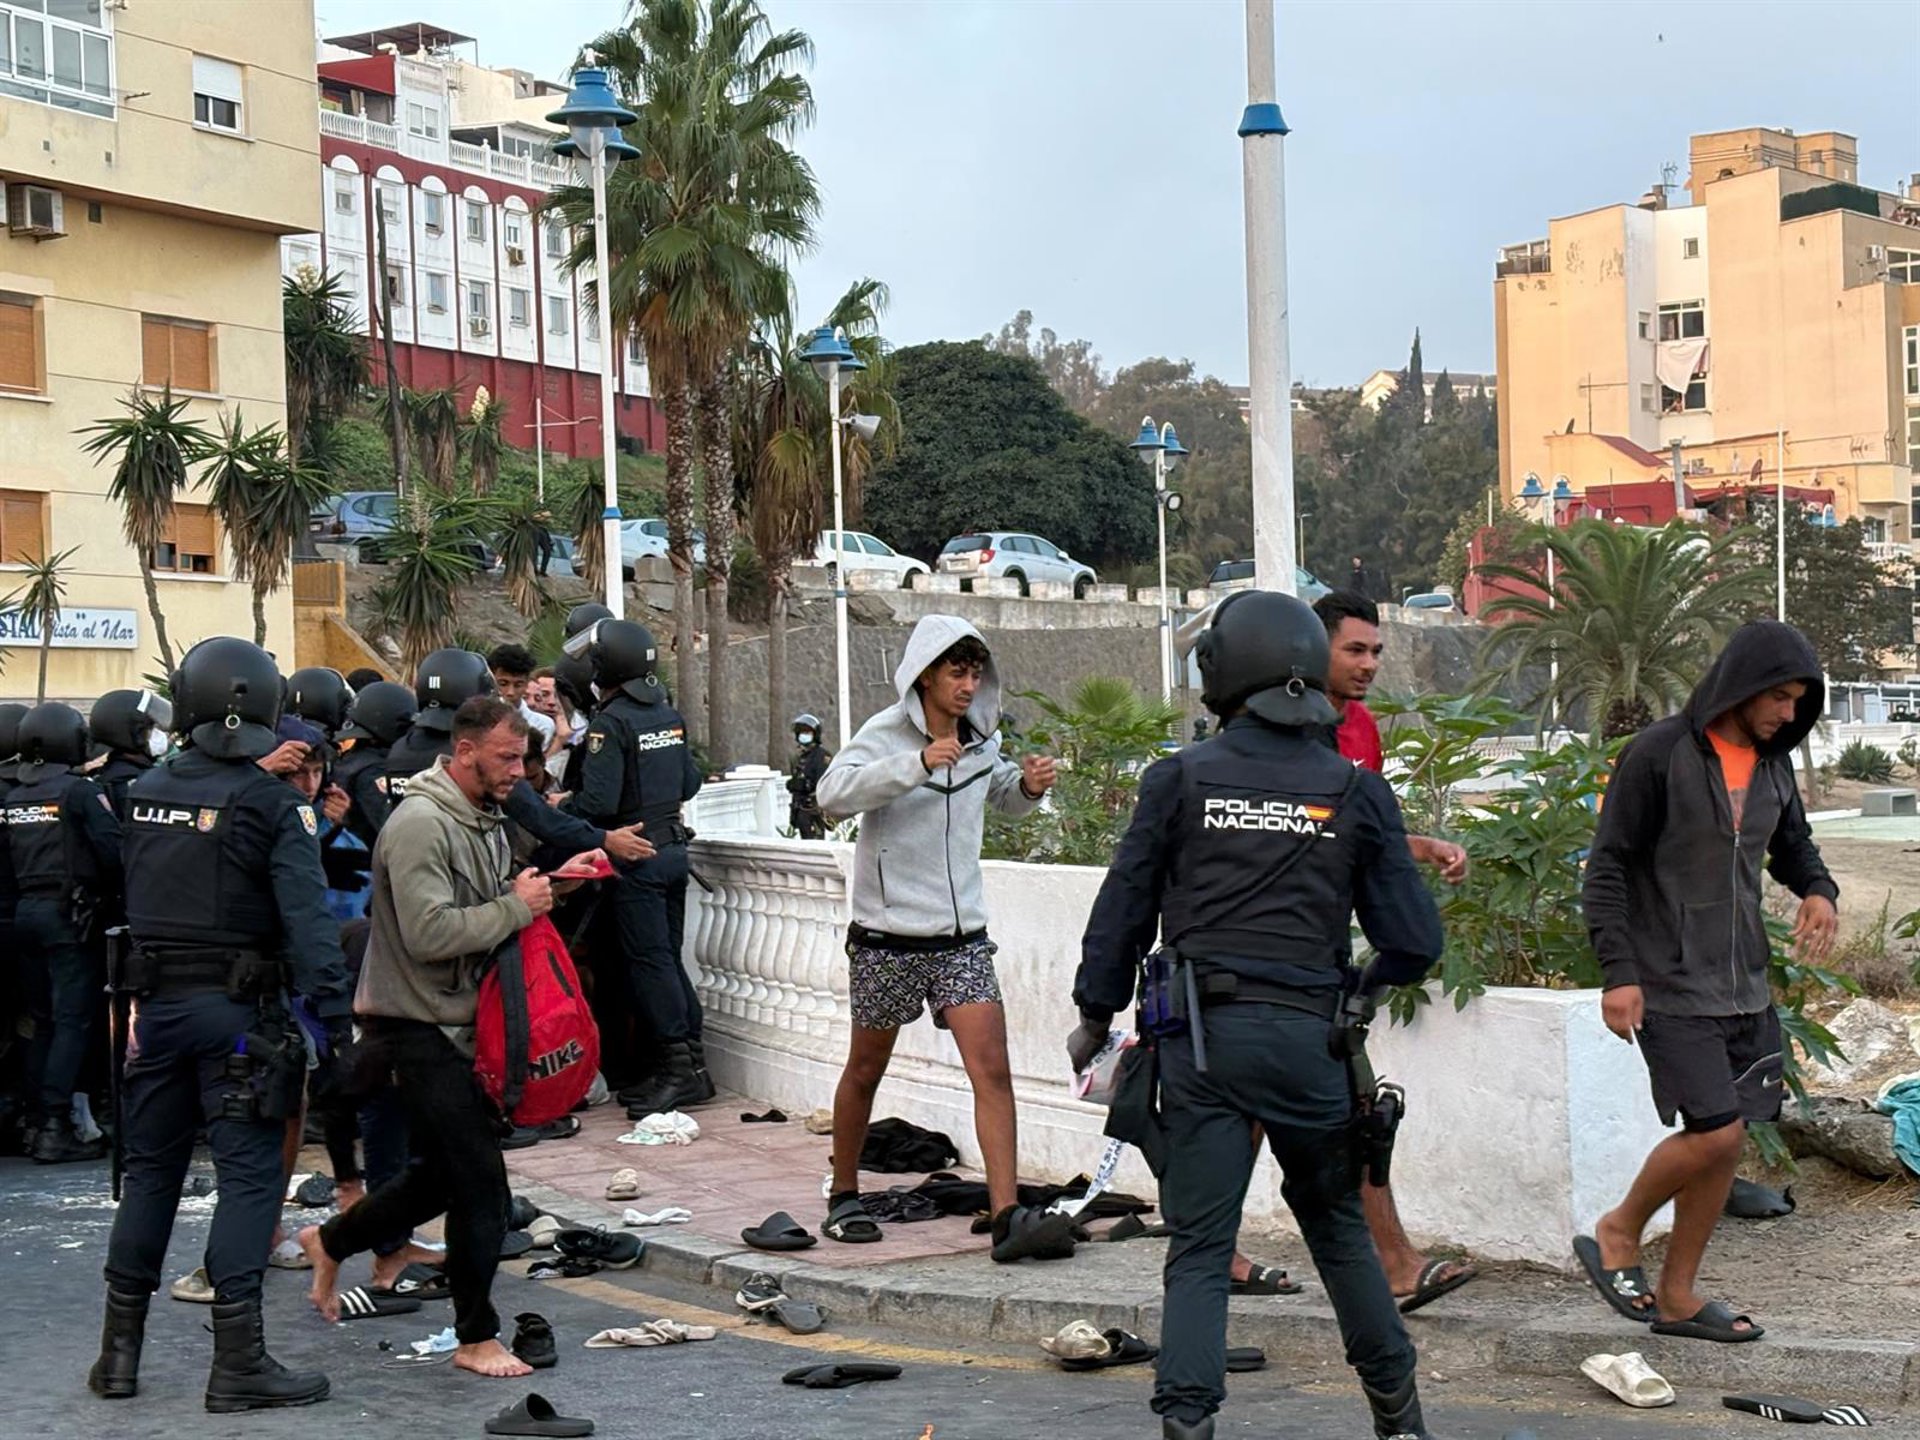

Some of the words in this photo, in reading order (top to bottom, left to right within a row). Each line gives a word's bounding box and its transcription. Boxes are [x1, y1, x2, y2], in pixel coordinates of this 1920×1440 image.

[53, 621, 78, 638] ista
[82, 621, 96, 639] al
[101, 619, 134, 640] Mar
[639, 730, 673, 743] POLICIA
[640, 737, 684, 751] NACIONAL
[7, 806, 48, 816] POLICIA
[132, 806, 195, 827] U.I.P.
[1205, 799, 1310, 818] POLICIA
[8, 813, 60, 825] NACIONAL
[528, 1039, 584, 1080] NIKE
